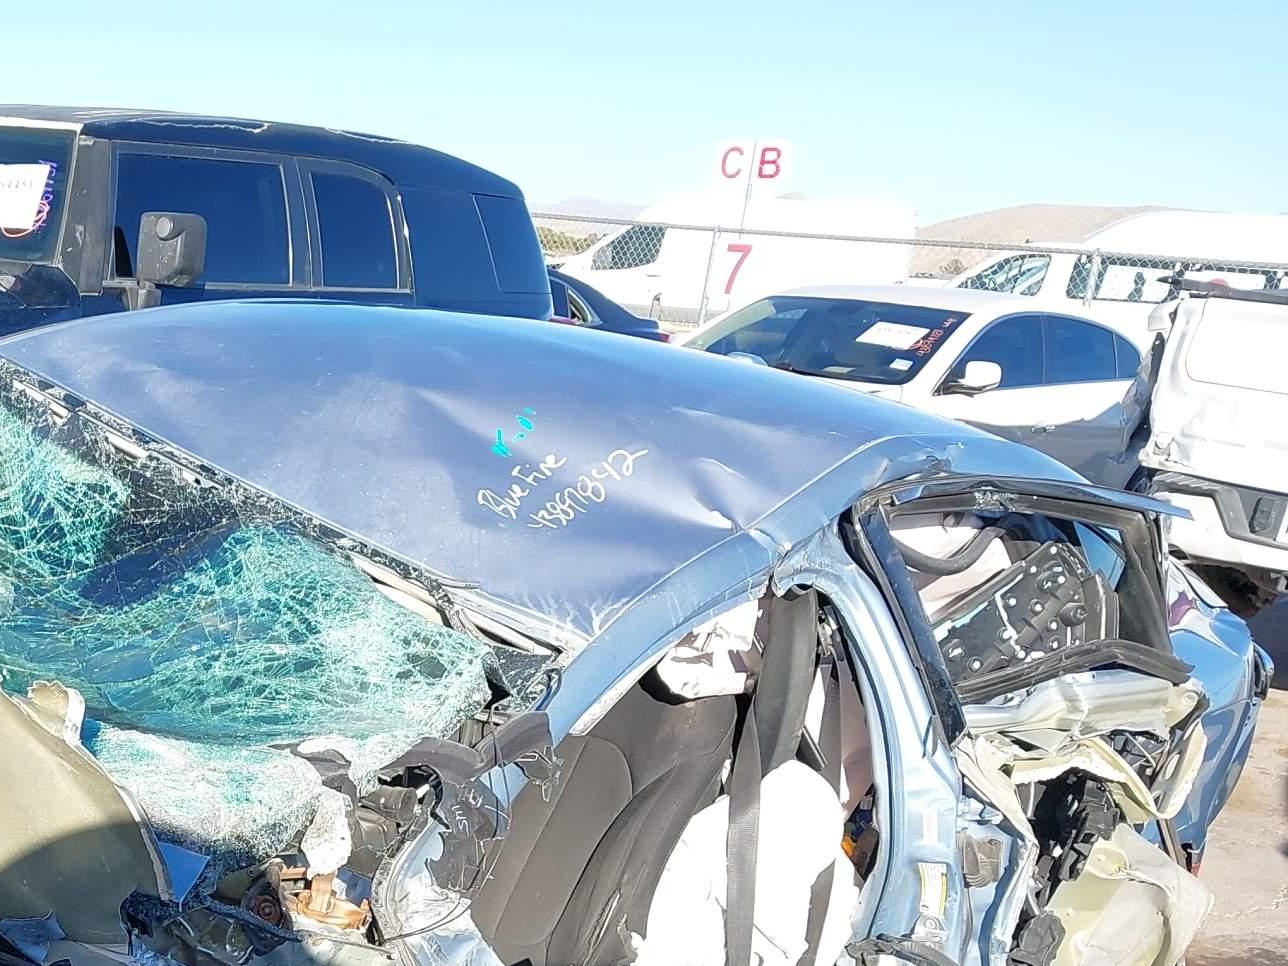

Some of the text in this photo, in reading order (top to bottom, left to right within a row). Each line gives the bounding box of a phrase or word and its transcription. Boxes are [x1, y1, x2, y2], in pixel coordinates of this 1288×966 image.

[721, 146, 782, 178] C B
[724, 243, 753, 295] 7
[526, 449, 649, 529] 43897842
